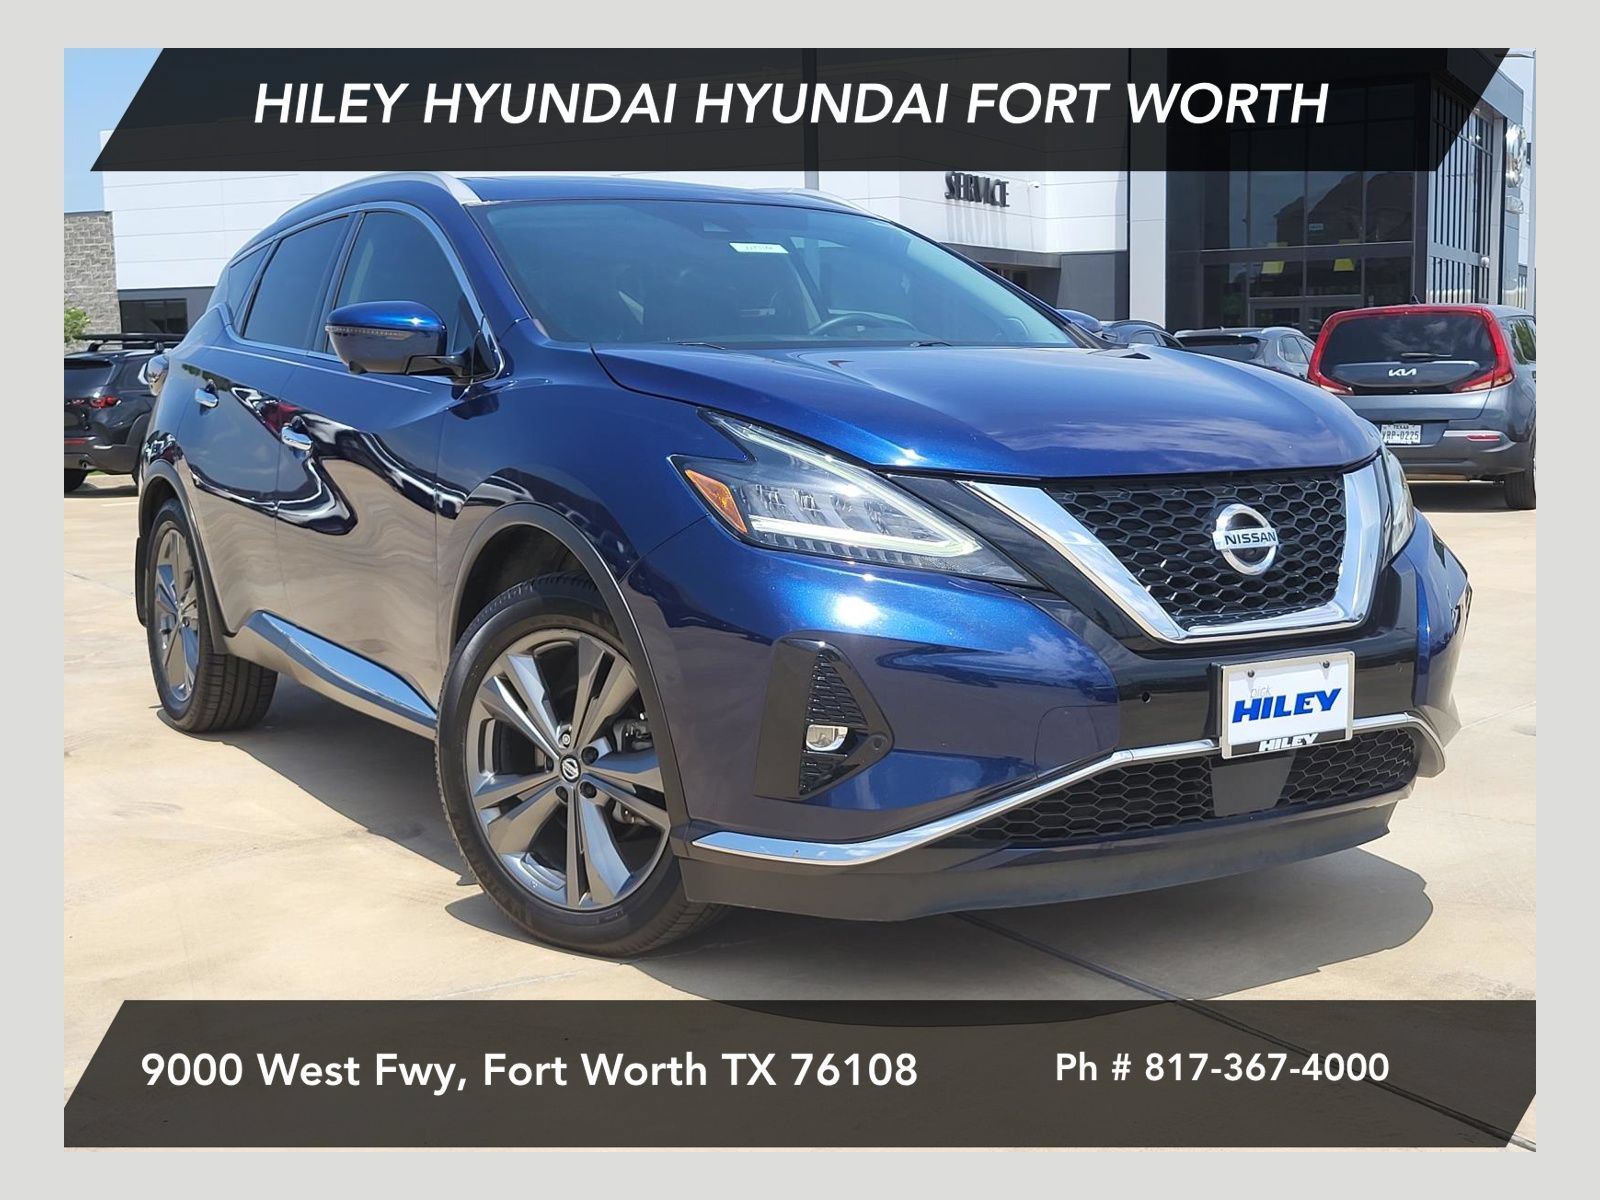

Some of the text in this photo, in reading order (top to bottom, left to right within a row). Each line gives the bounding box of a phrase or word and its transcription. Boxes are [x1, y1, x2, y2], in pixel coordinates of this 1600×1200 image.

[945, 171, 1010, 207] SERVICE
[1225, 531, 1276, 545] NISSAN
[1232, 688, 1341, 723] HILEY
[1258, 732, 1318, 752] HILEY
